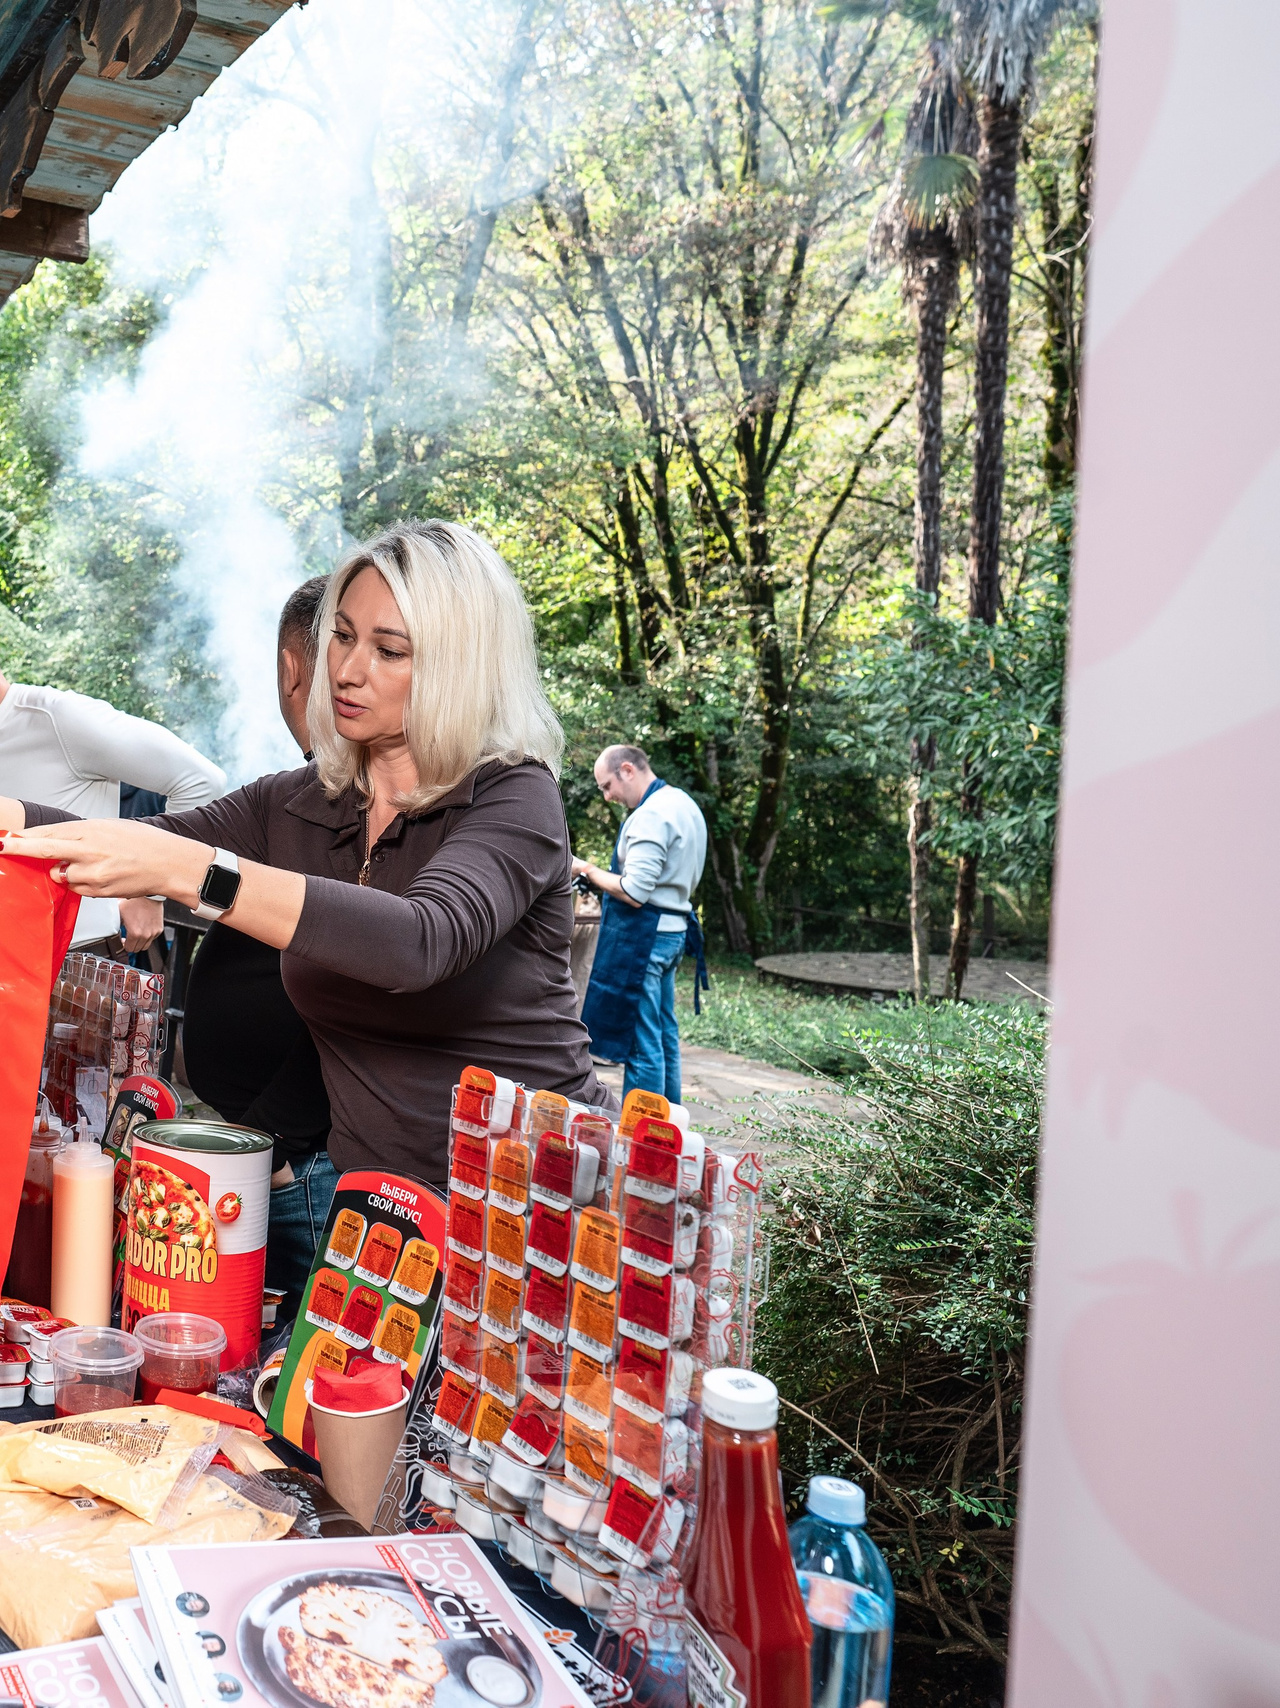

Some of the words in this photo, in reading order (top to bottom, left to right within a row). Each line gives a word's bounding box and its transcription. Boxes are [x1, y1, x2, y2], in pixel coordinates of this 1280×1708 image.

[133, 1092, 147, 1106] СВОЙ
[144, 1098, 160, 1112] ВКУС!
[140, 1083, 160, 1099] ВЫБЕРИ
[367, 1193, 394, 1213] СВОЙ
[393, 1203, 423, 1225] ВКУС!
[380, 1181, 419, 1206] ВЫБЕРИ
[169, 1244, 219, 1284] PRO
[126, 1273, 171, 1312] ПИЦЦА
[400, 1542, 483, 1640] СОУСЫ
[426, 1541, 514, 1638] НОВЫЕ
